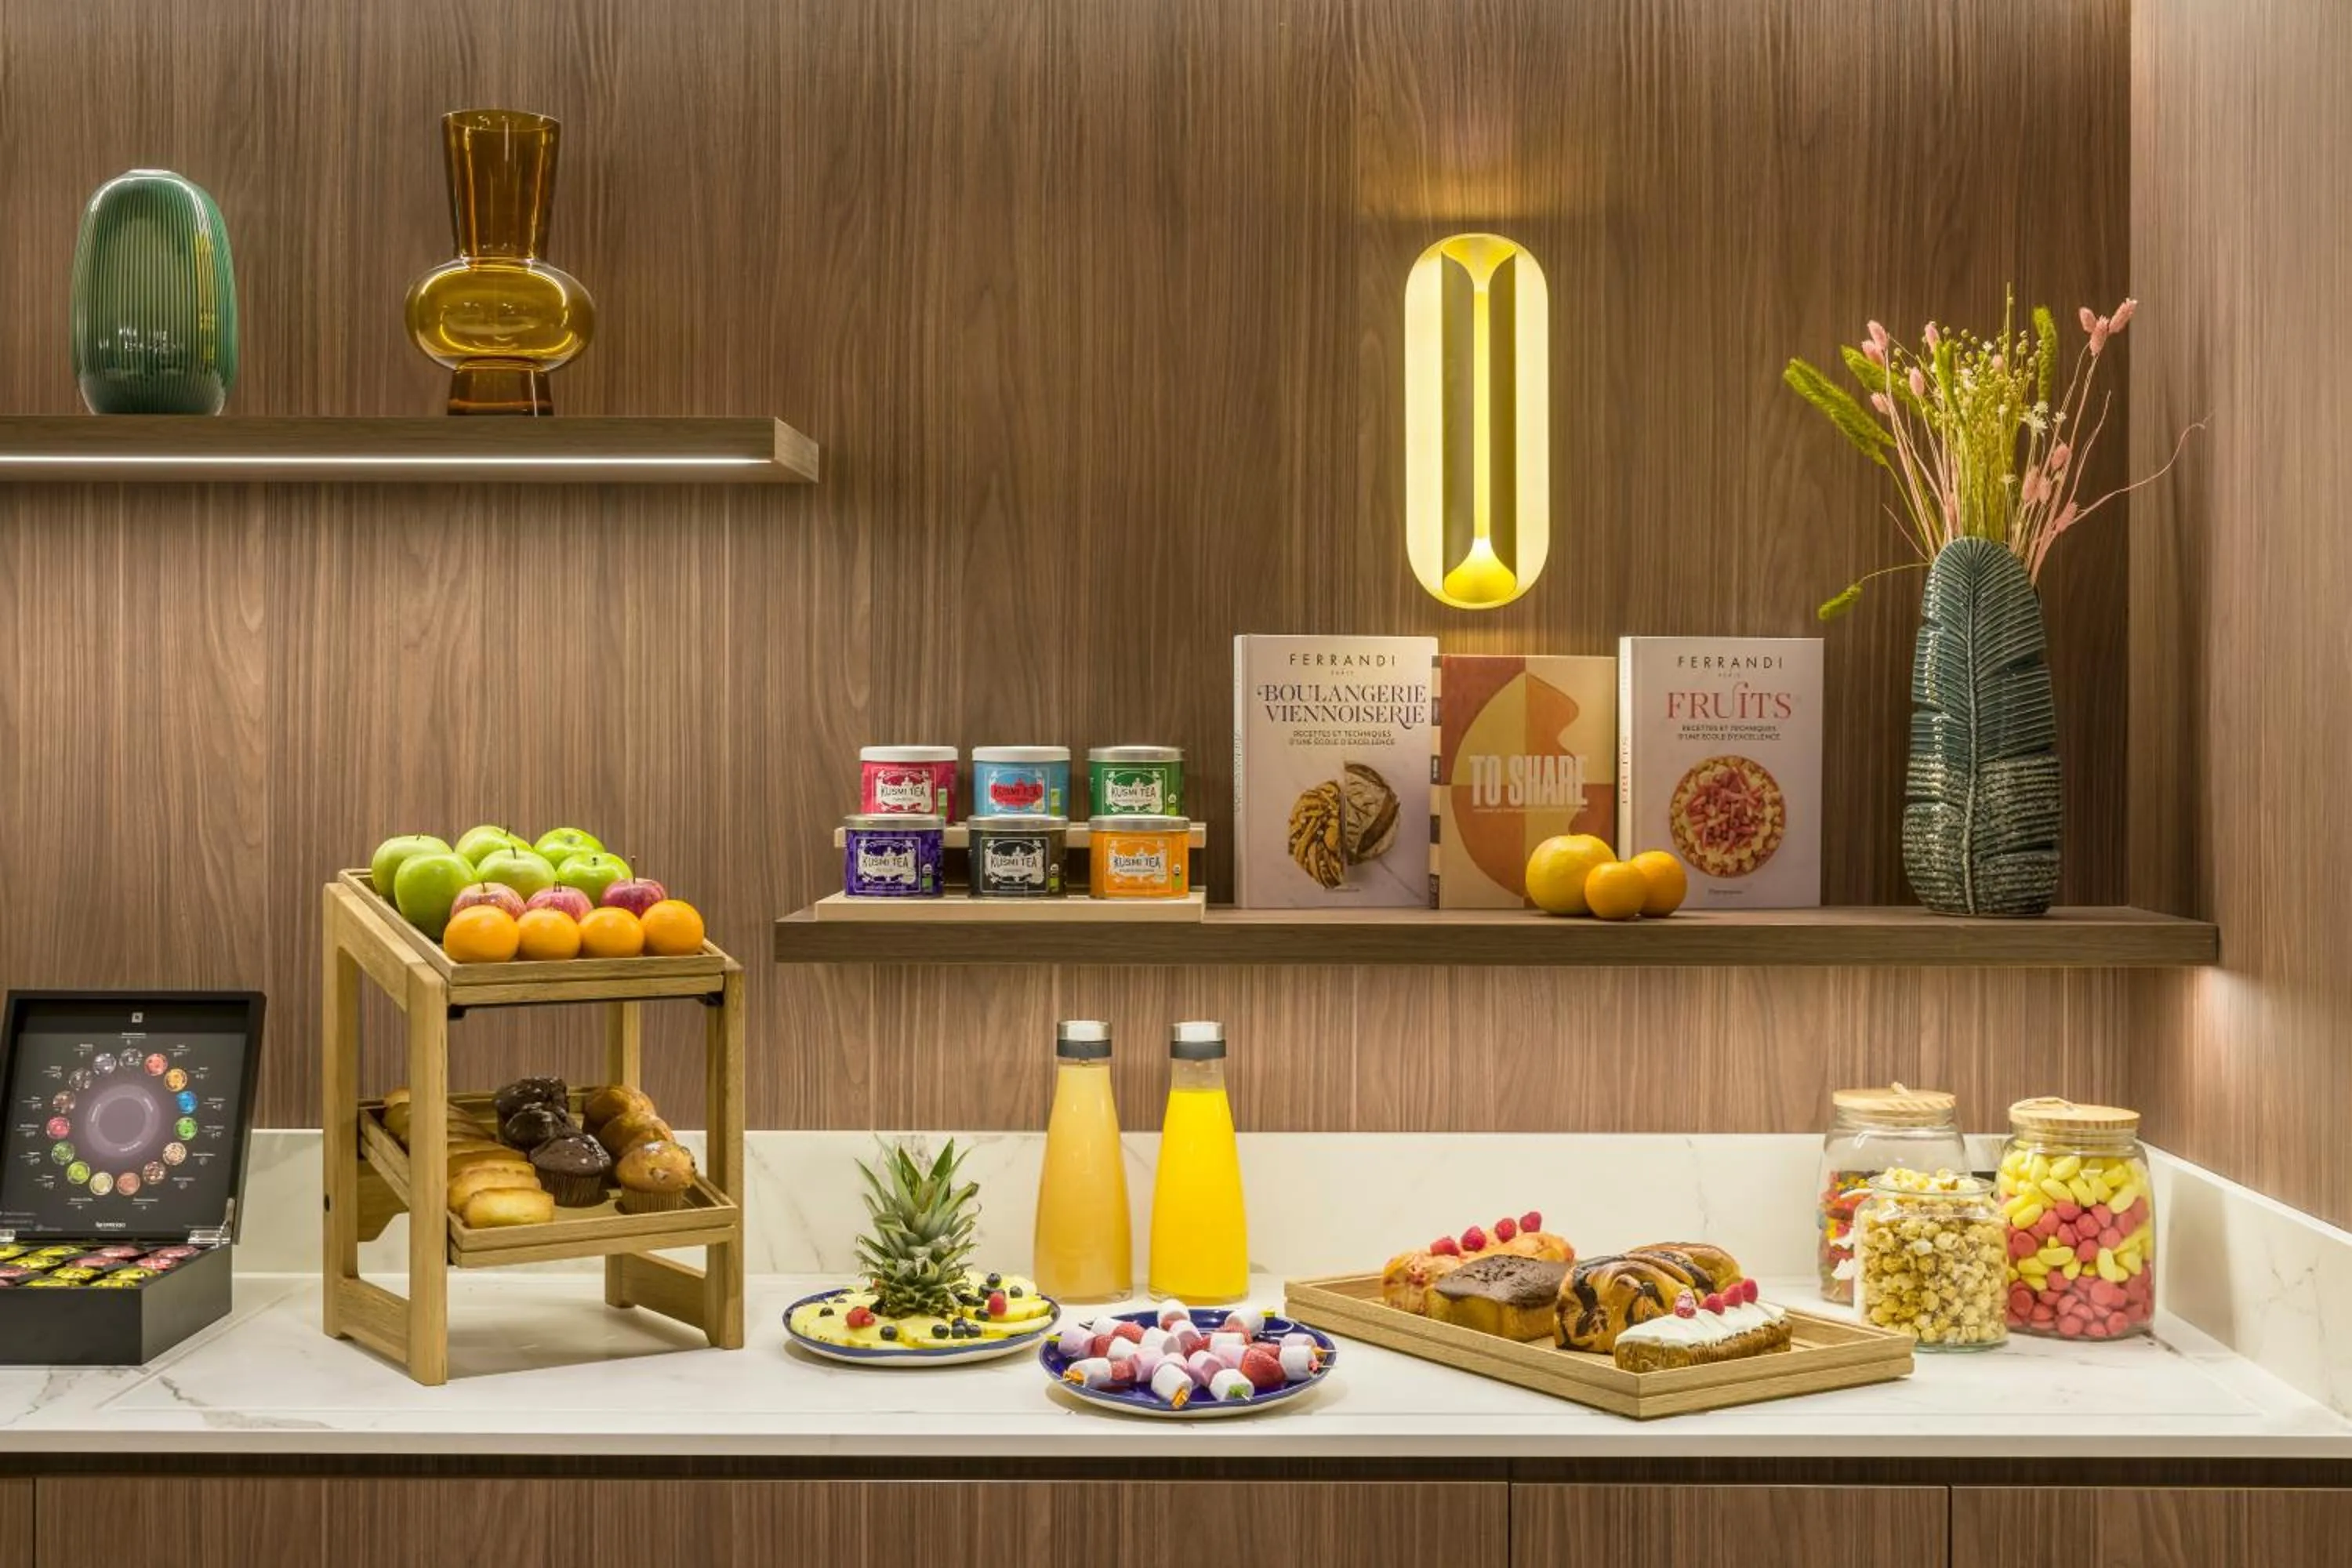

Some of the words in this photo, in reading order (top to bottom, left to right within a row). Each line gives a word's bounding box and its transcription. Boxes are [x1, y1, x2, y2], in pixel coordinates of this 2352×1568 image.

[1290, 654, 1396, 666] FERRANDI
[1678, 656, 1783, 669] FERRANDI
[1258, 684, 1427, 703] BOULANGERIE
[1668, 681, 1792, 719] FRUITS
[1266, 705, 1425, 730] VIENNOISERIE
[1469, 754, 1501, 807] TO
[1508, 754, 1588, 807] SHARE
[880, 786, 907, 797] KUSMI
[909, 786, 926, 797] TEA
[1111, 786, 1138, 797] KUSMI
[1140, 786, 1156, 797] TEA
[863, 856, 890, 868] KUSMI
[892, 855, 909, 868] TEA
[990, 855, 1018, 868] KUSMI
[1021, 856, 1037, 868] TEA
[1113, 856, 1142, 868] KUSMI
[1145, 856, 1161, 869] TEA
